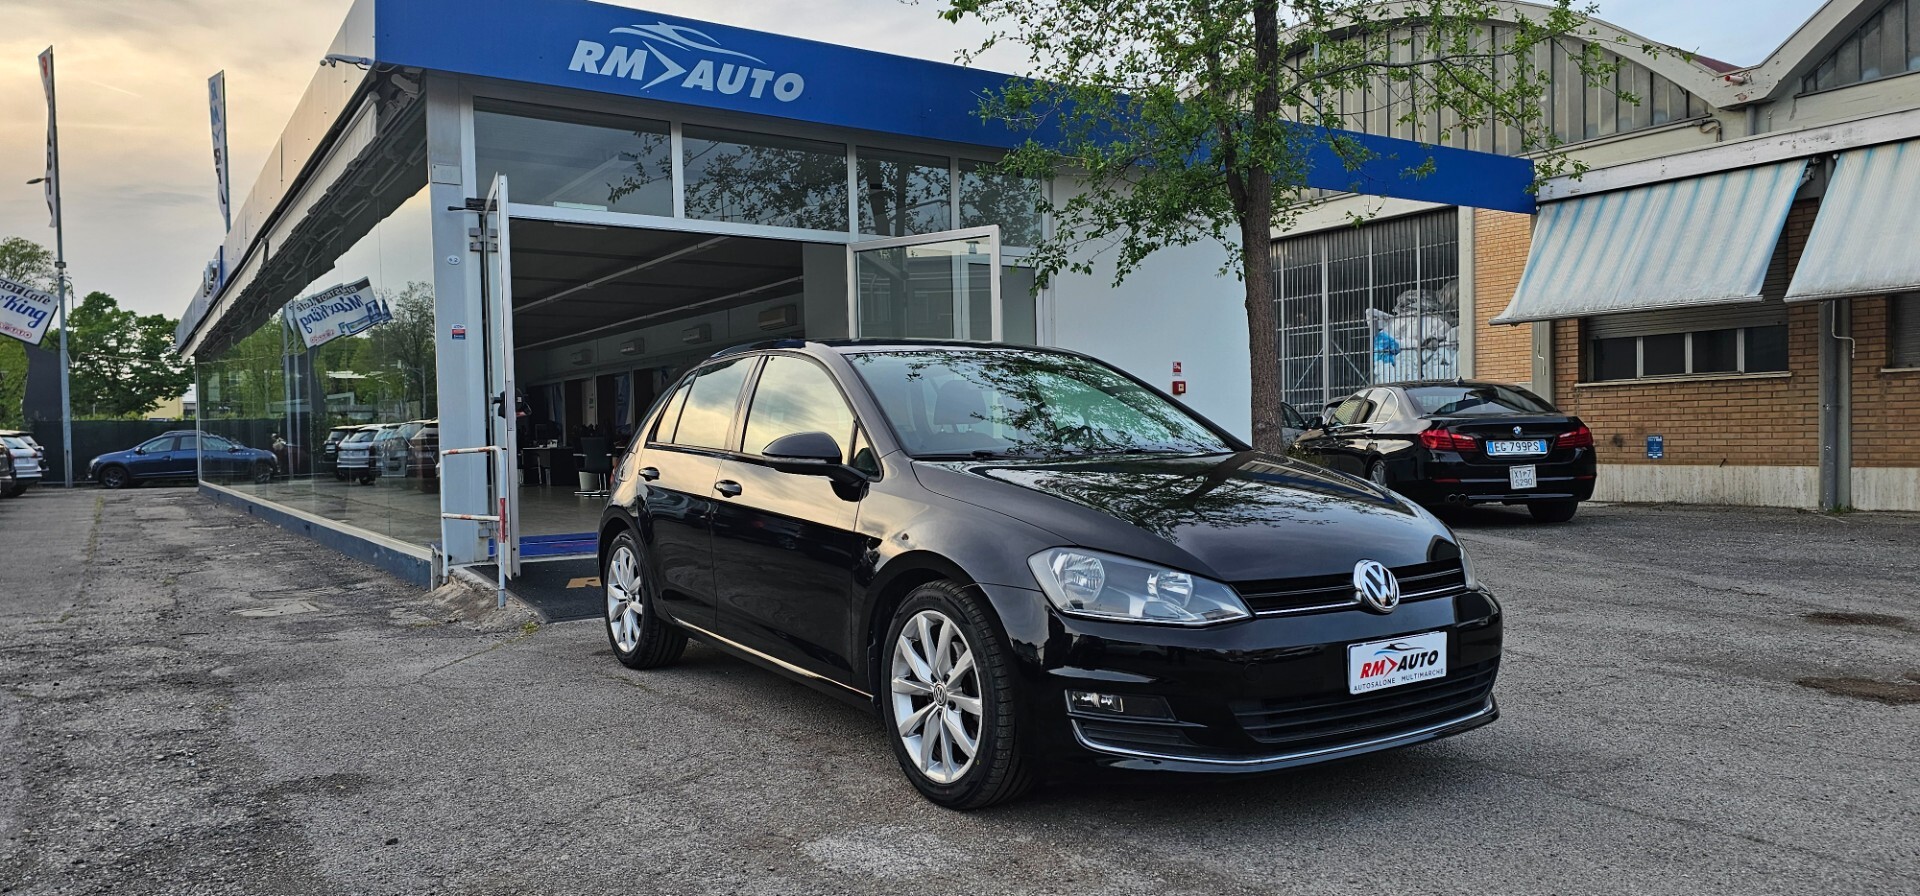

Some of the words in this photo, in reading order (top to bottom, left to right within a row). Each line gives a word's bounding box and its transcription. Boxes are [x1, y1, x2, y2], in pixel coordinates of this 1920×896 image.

[568, 40, 648, 81] RM
[681, 59, 805, 102] AUTO
[3, 294, 48, 329] King
[1495, 441, 1506, 452] EG
[1509, 441, 1539, 452] 799PS
[1360, 660, 1385, 679] RM
[1397, 650, 1438, 672] AUTO
[1354, 678, 1395, 691] AUTOSALONE
[1401, 668, 1443, 681] MULTIMARCHE
